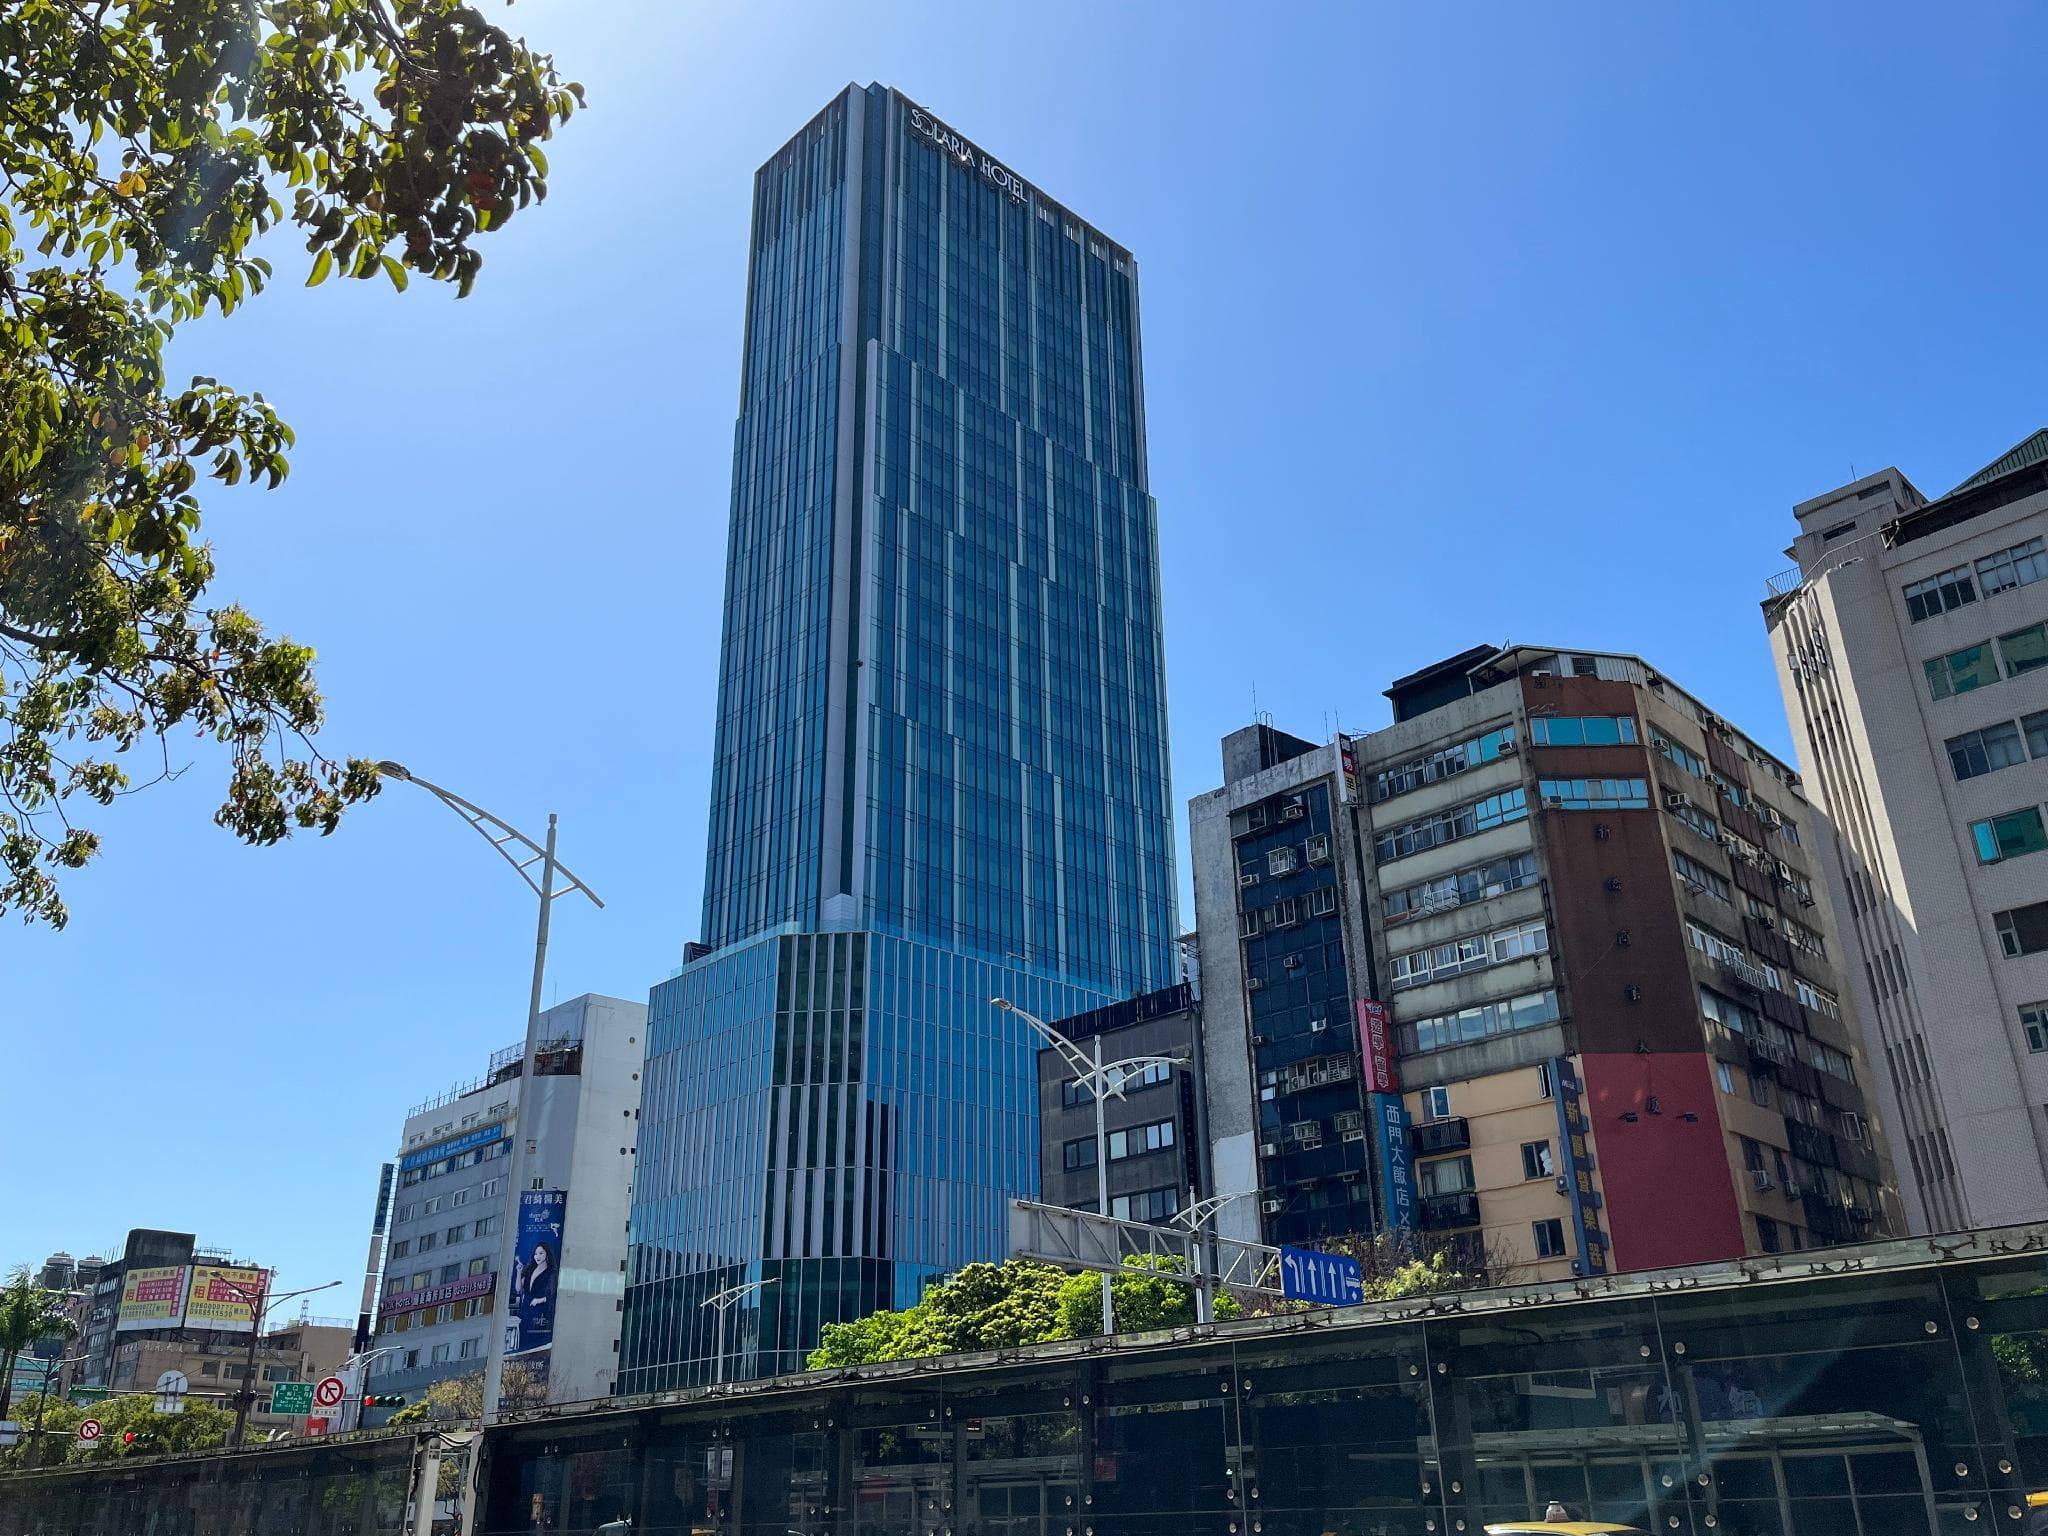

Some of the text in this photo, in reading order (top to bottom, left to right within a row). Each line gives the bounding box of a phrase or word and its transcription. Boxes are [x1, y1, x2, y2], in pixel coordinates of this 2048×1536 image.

[911, 108, 1028, 203] SOLARIA HOTEL
[1386, 1104, 1410, 1208] 西門大飯店
